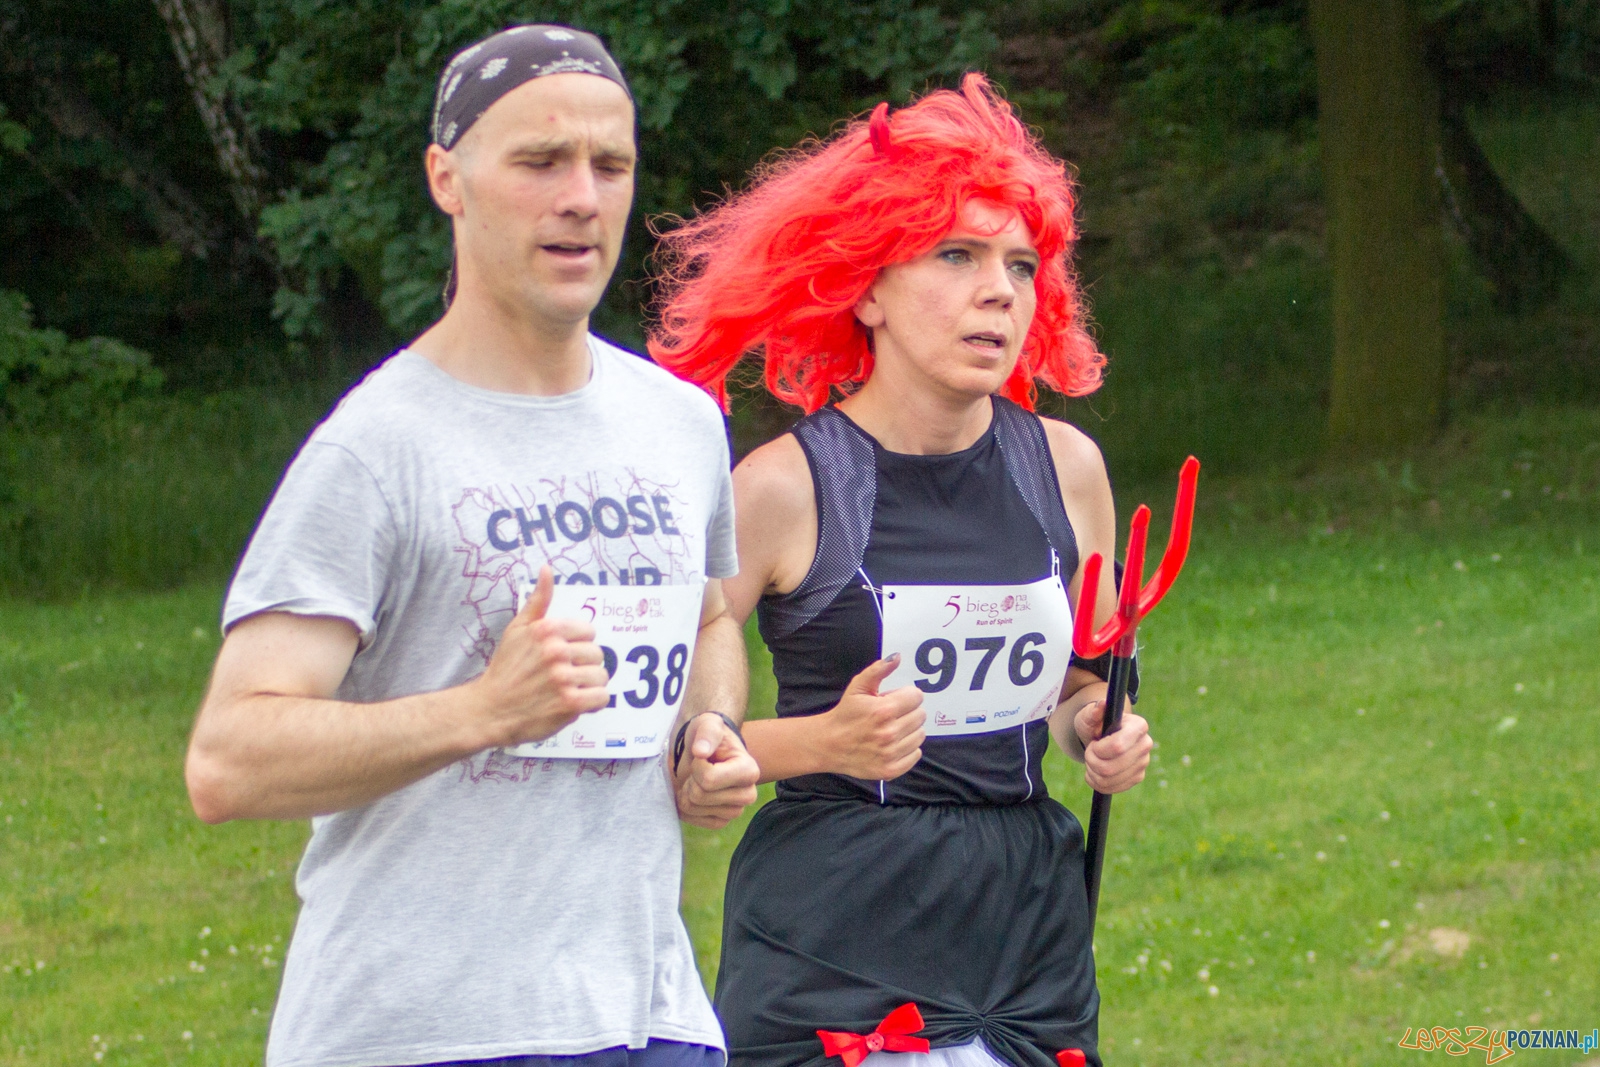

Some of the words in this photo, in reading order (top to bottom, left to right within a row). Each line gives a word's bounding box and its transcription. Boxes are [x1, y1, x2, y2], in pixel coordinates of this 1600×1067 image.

[487, 495, 680, 551] CHOOSE
[649, 597, 661, 606] na
[1015, 593, 1028, 602] na
[581, 597, 597, 623] 5
[602, 598, 634, 623] bieg
[942, 594, 961, 628] 5
[966, 596, 1000, 618] bieg
[1014, 601, 1031, 611] tak
[649, 606, 665, 618] tak
[989, 618, 997, 626] of
[997, 618, 1013, 626] Spirit
[612, 624, 624, 632] Run
[625, 624, 632, 632] of
[633, 624, 648, 632] Spirit
[914, 632, 1047, 694] 976
